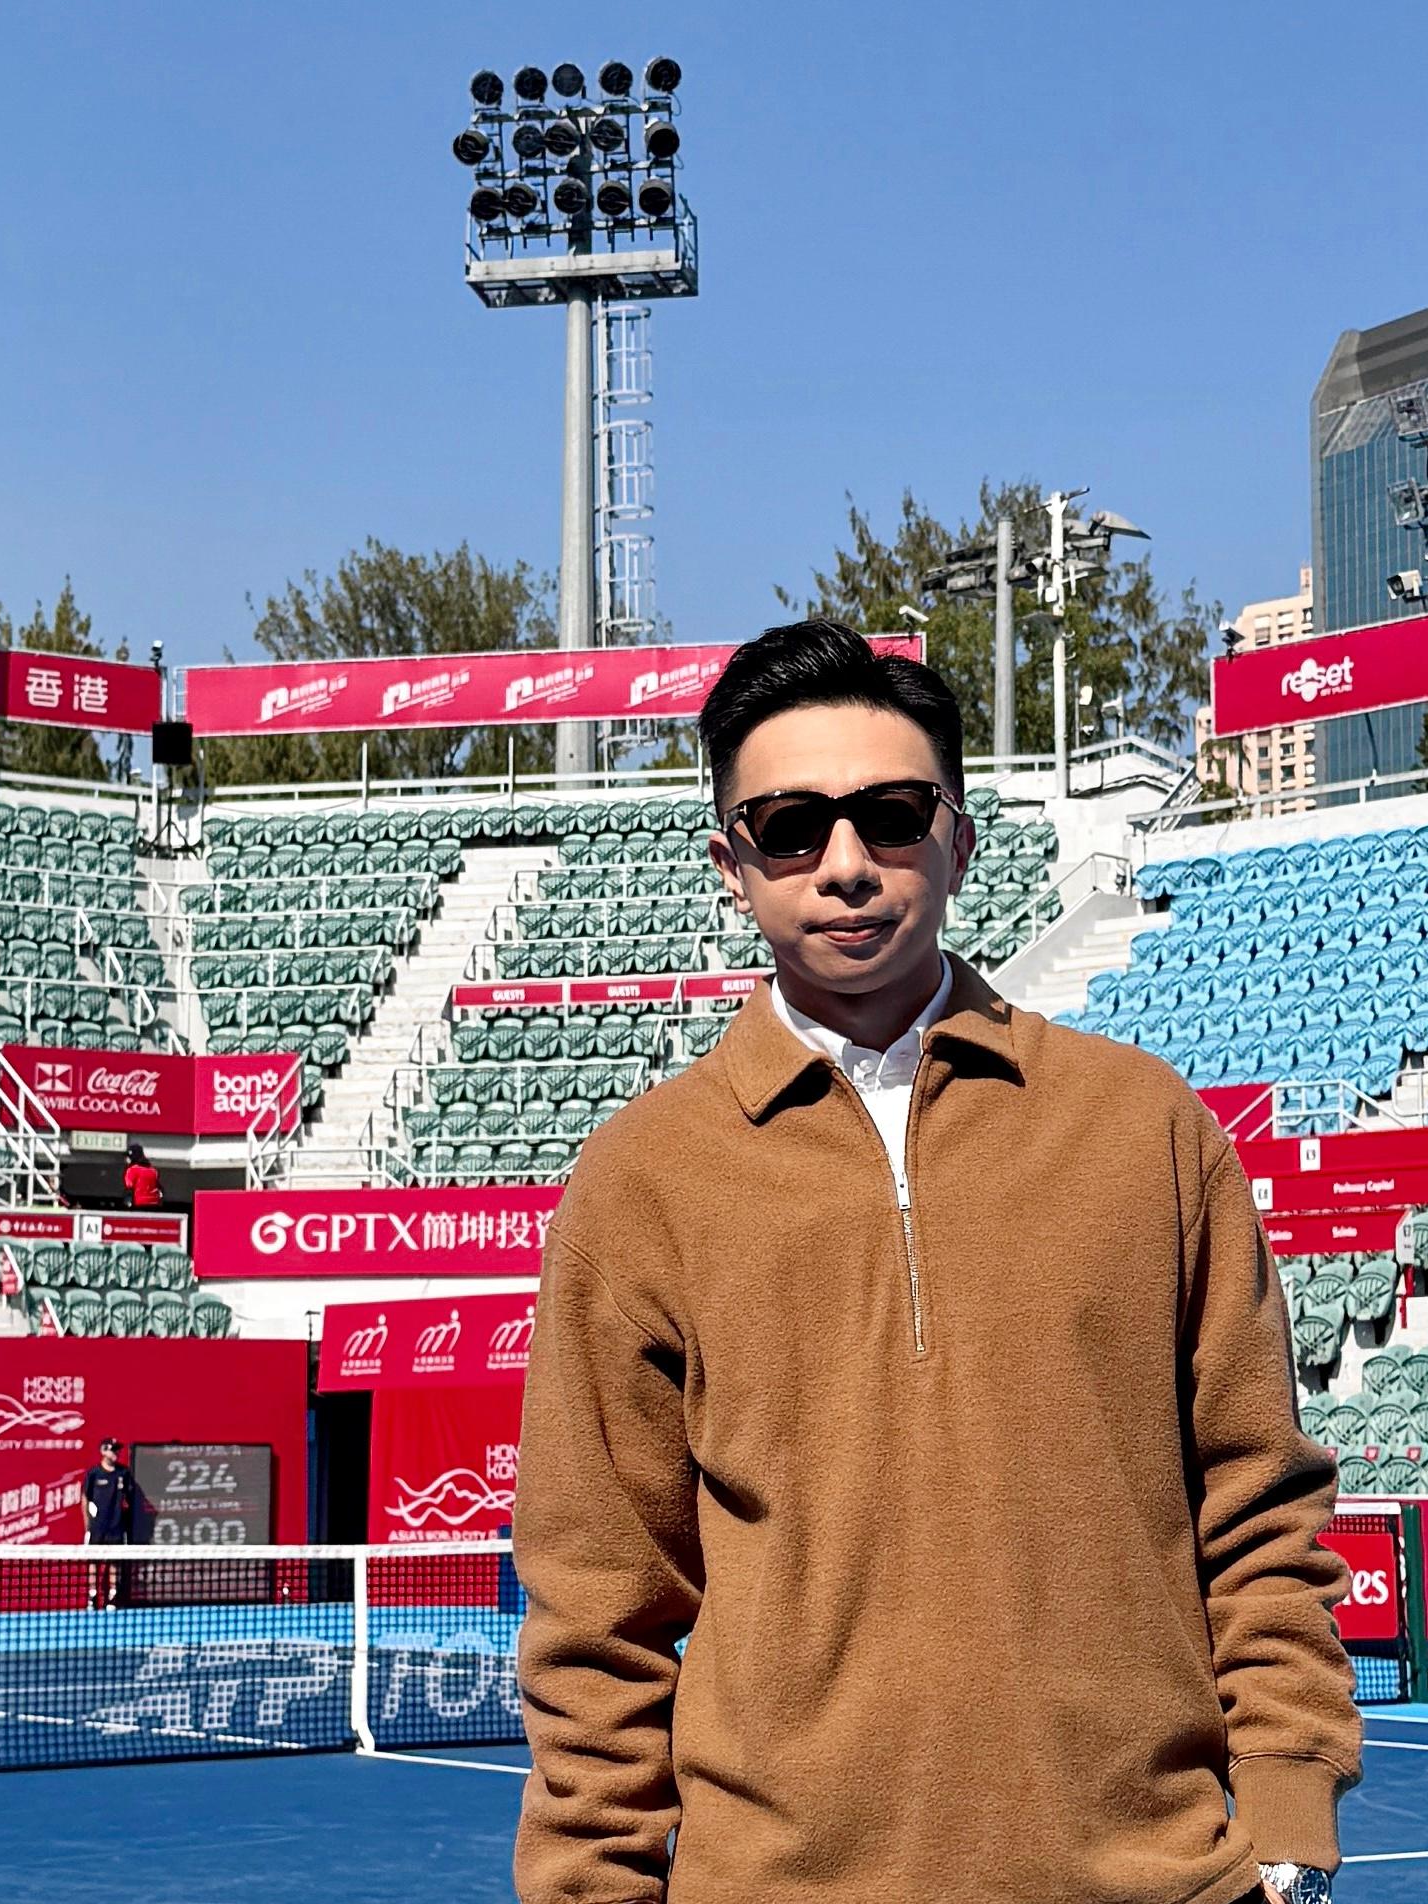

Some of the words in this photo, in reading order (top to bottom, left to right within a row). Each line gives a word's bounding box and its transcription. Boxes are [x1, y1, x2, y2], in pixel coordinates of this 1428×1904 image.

[25, 667, 109, 714] 香港
[492, 989, 525, 1001] GUESTS
[607, 985, 640, 997] GUESTS
[722, 979, 755, 992] GUESTS
[87, 1067, 160, 1097] Coca-Cola
[213, 1071, 262, 1093] bon
[295, 1212, 420, 1254] GPTX
[486, 1443, 521, 1462] HON
[165, 1459, 238, 1494] 224
[486, 1461, 518, 1480] KON
[376, 1630, 522, 1721] TO
